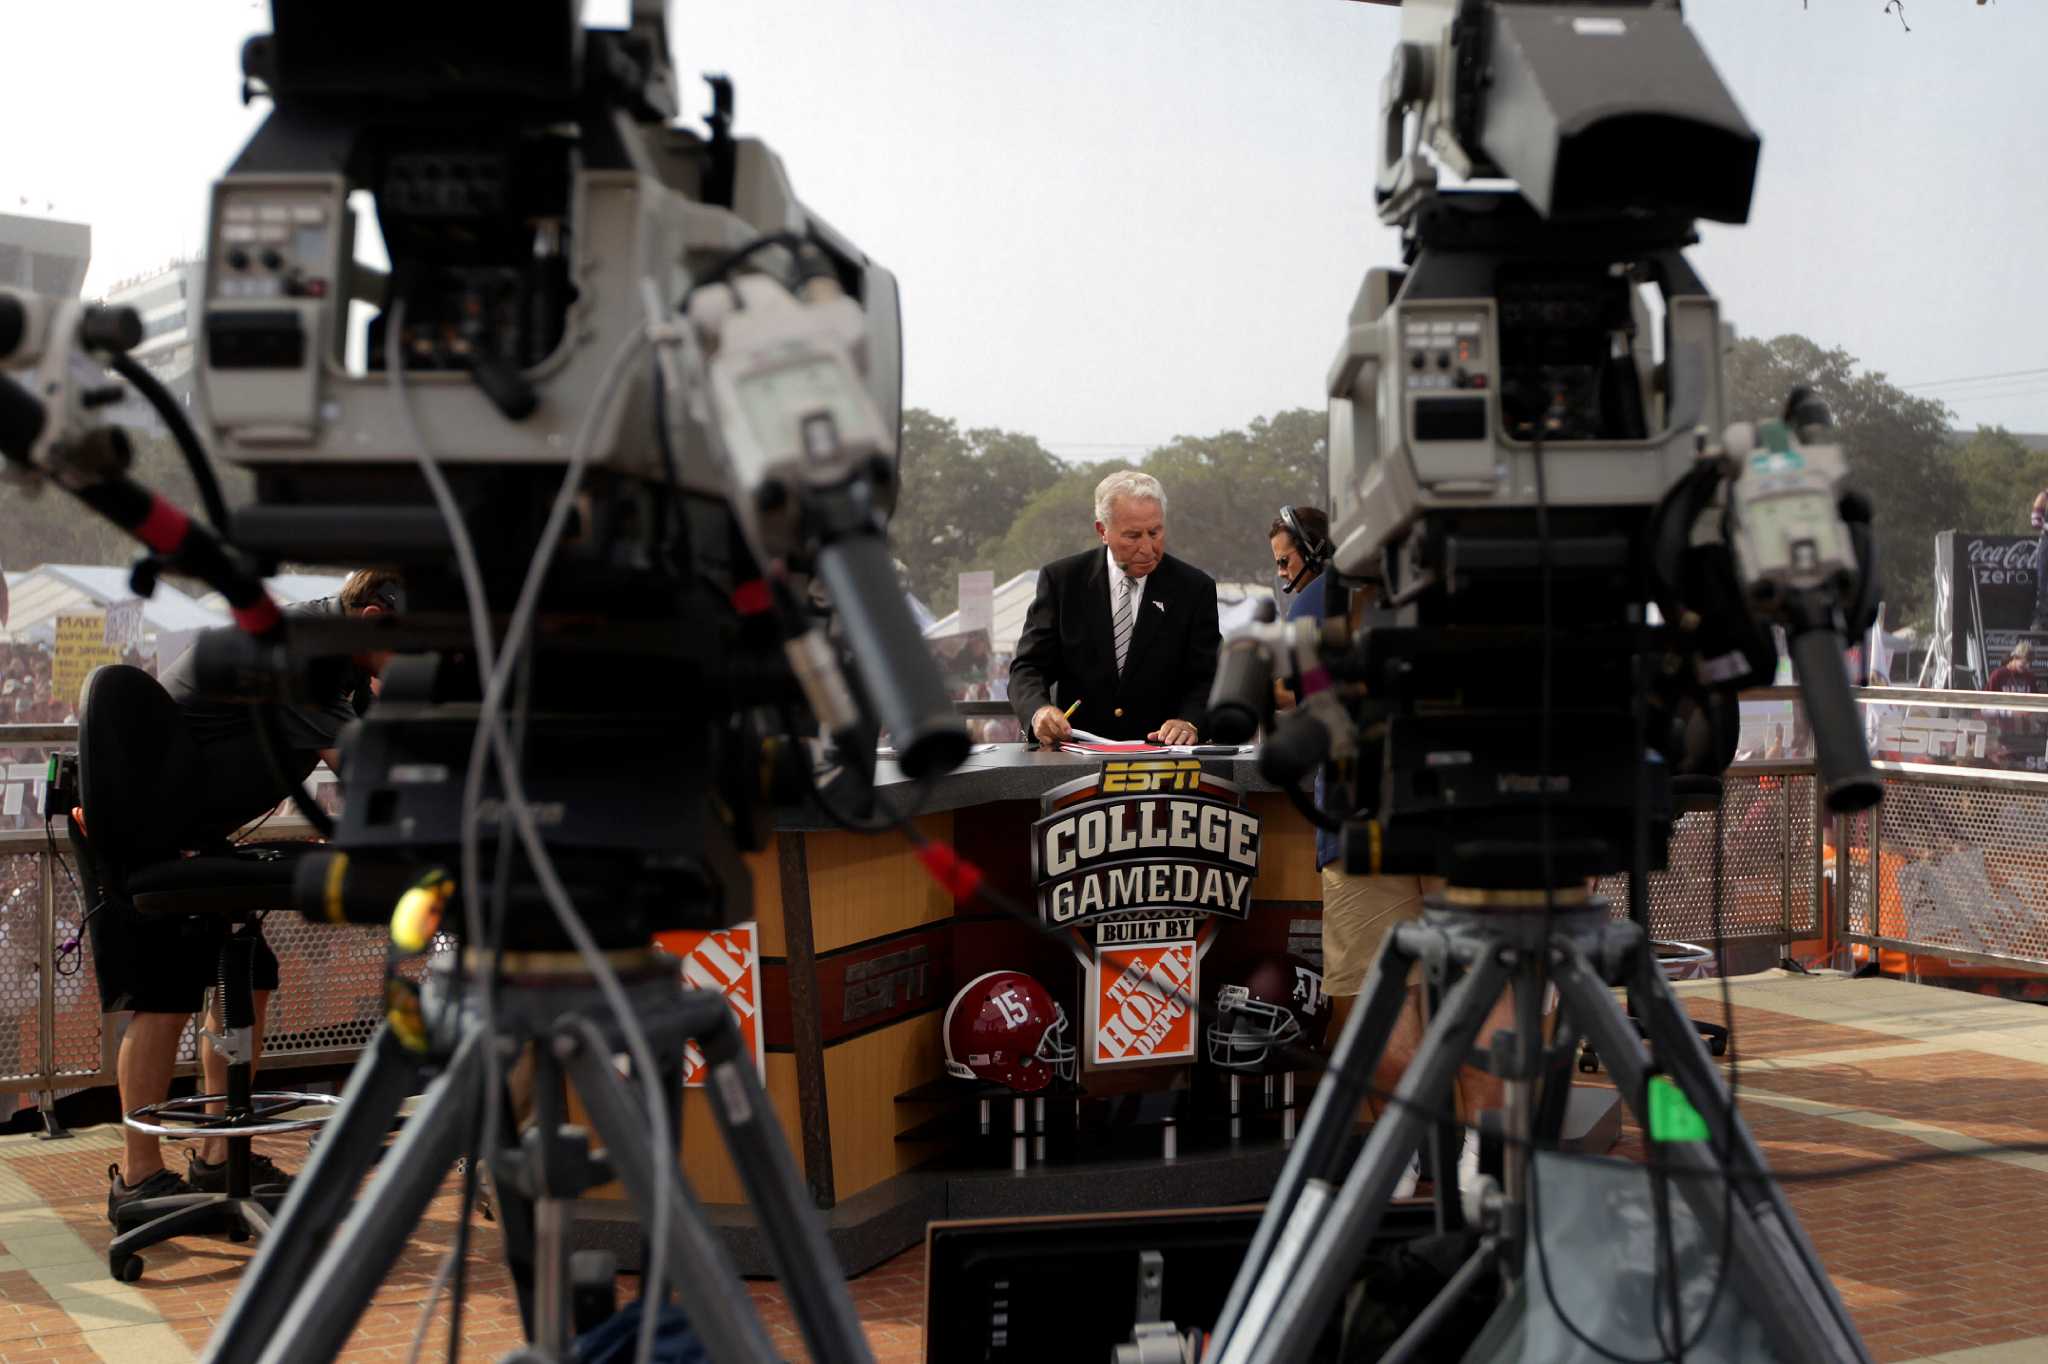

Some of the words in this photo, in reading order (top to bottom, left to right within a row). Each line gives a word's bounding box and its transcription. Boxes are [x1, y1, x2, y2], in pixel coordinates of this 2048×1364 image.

[1979, 571, 2029, 585] zero
[1103, 760, 1201, 792] ESPN
[1046, 800, 1259, 877] COLLEGE
[1052, 864, 1249, 922] GAMEDAY
[1103, 922, 1160, 941] BUILT
[1166, 919, 1190, 937] BY
[842, 944, 930, 1023] ESPN
[1099, 945, 1193, 1058] HOME
[1105, 956, 1150, 1004] THE
[991, 989, 1029, 1030] 15
